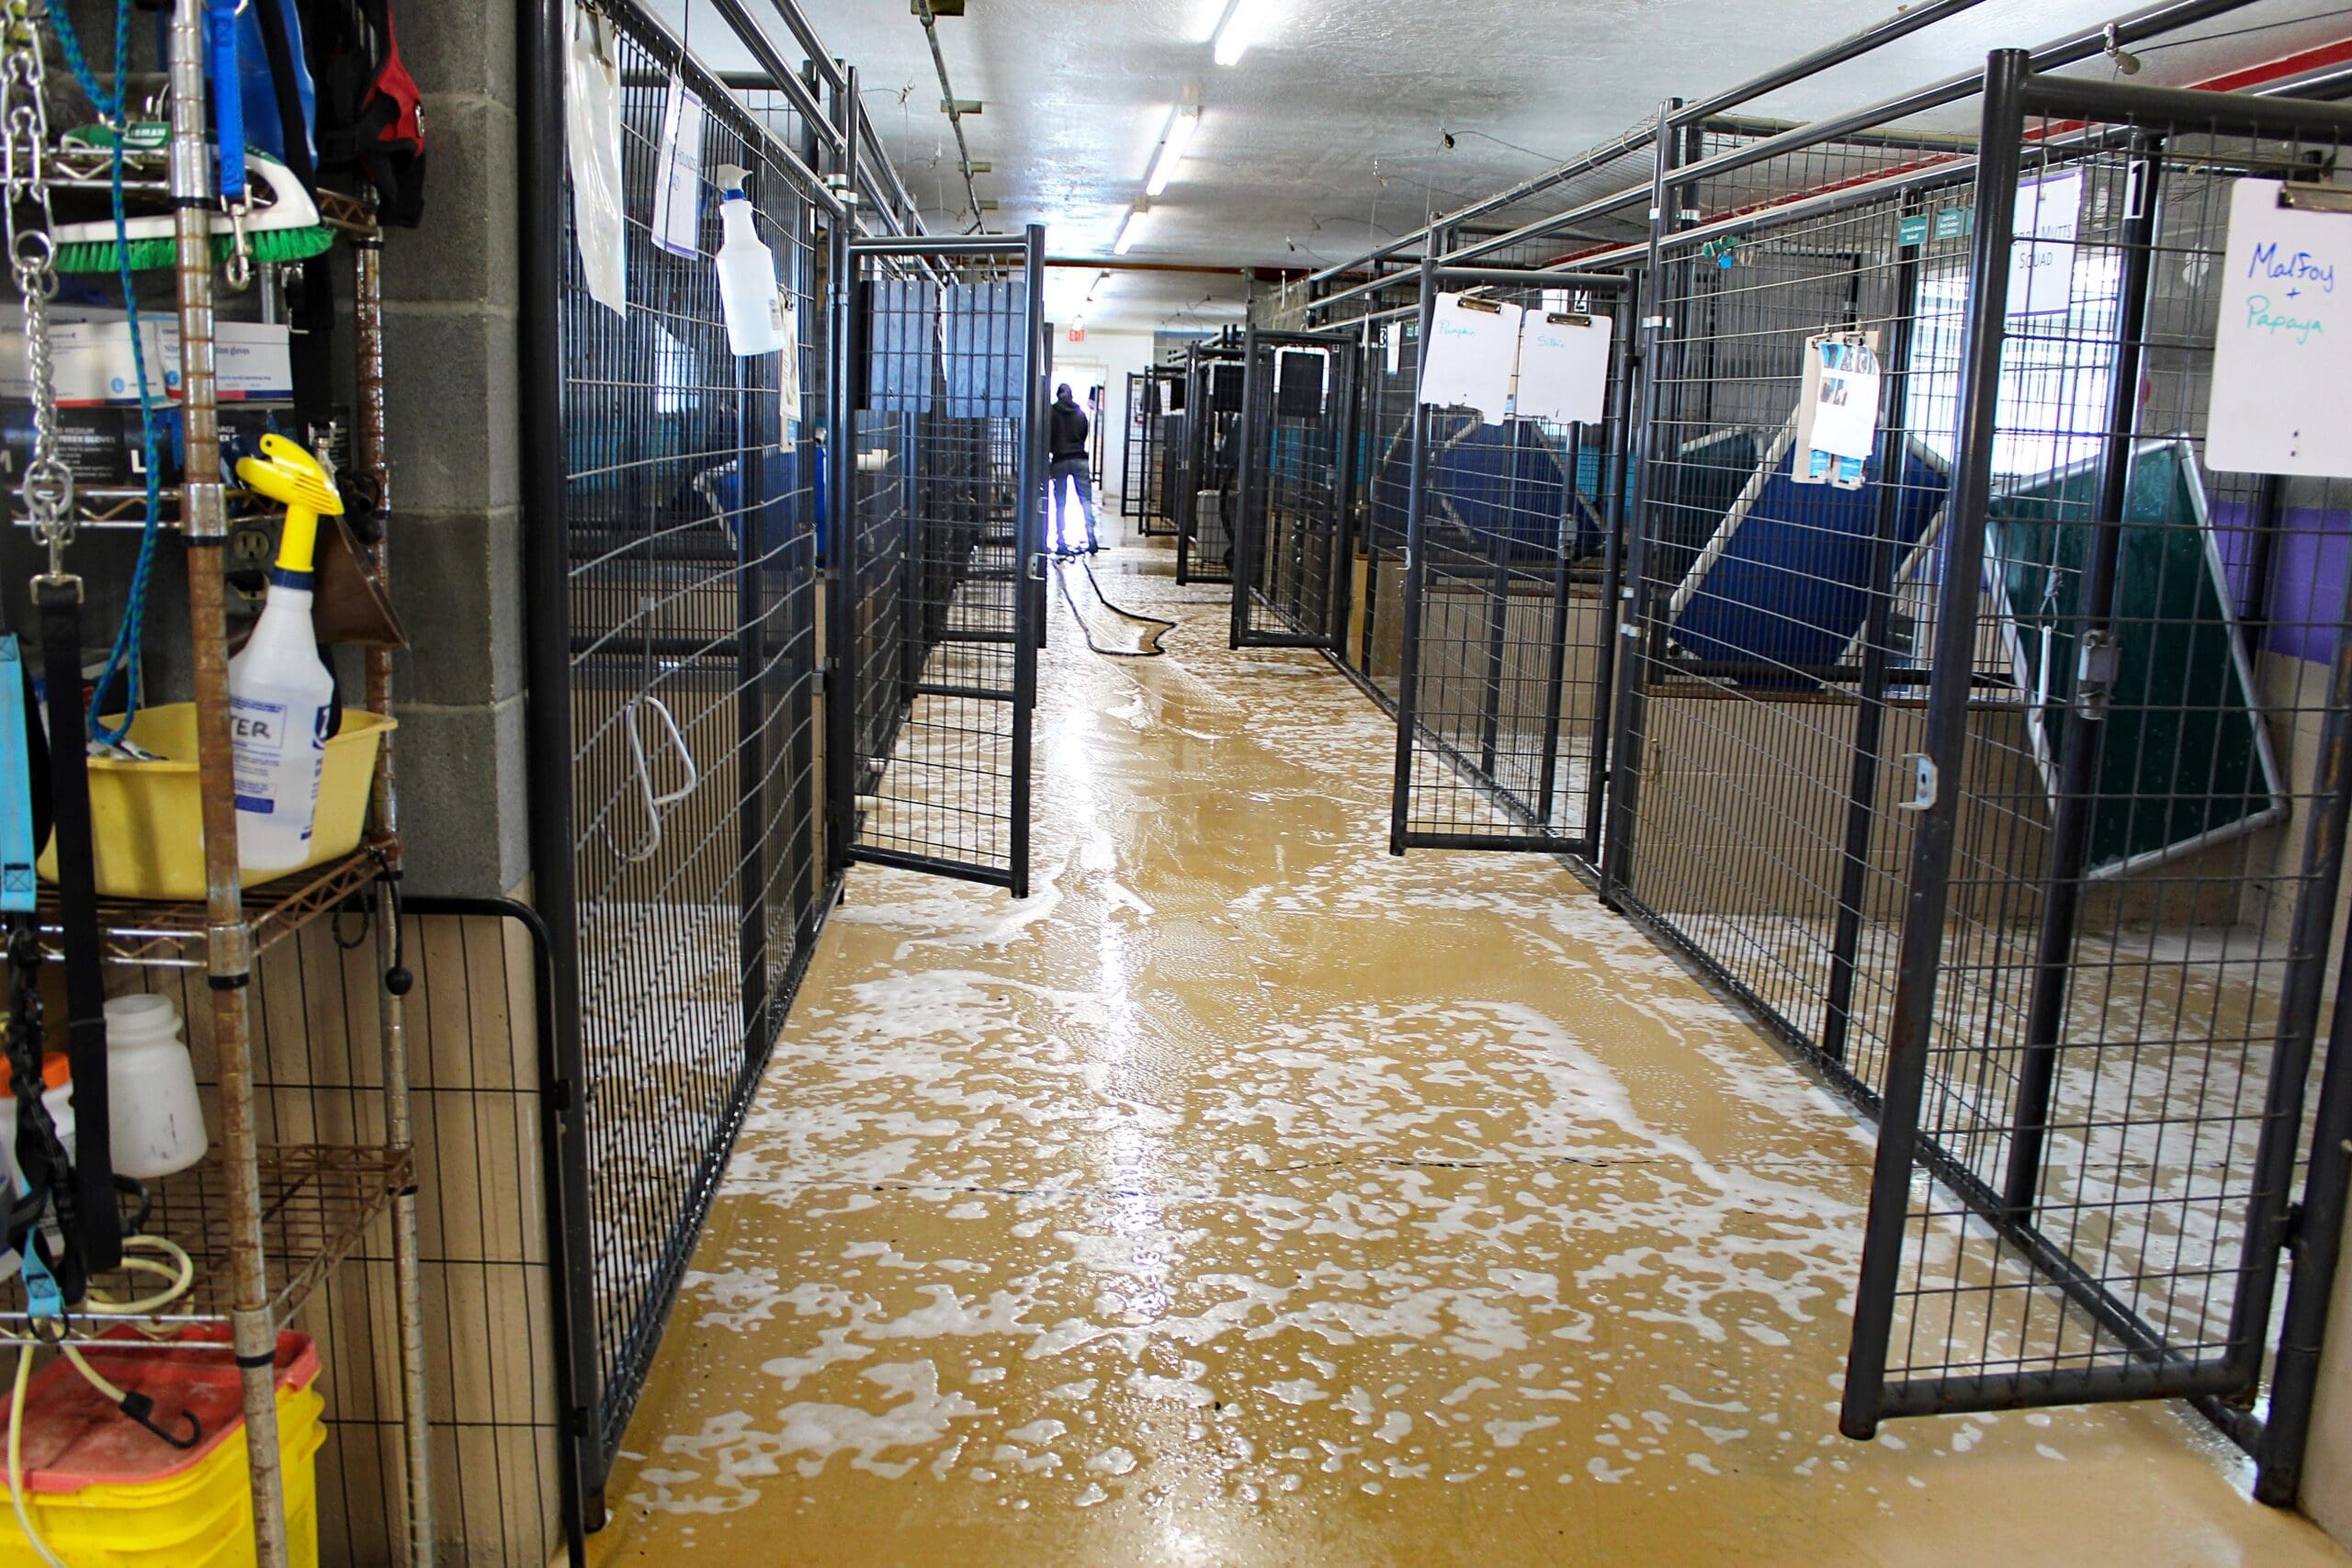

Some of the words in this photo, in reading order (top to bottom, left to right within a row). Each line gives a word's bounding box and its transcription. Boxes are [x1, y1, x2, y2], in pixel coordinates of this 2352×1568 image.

[2132, 163, 2143, 216] 1
[2246, 294, 2323, 345] Papaya
[230, 715, 270, 739] TER
